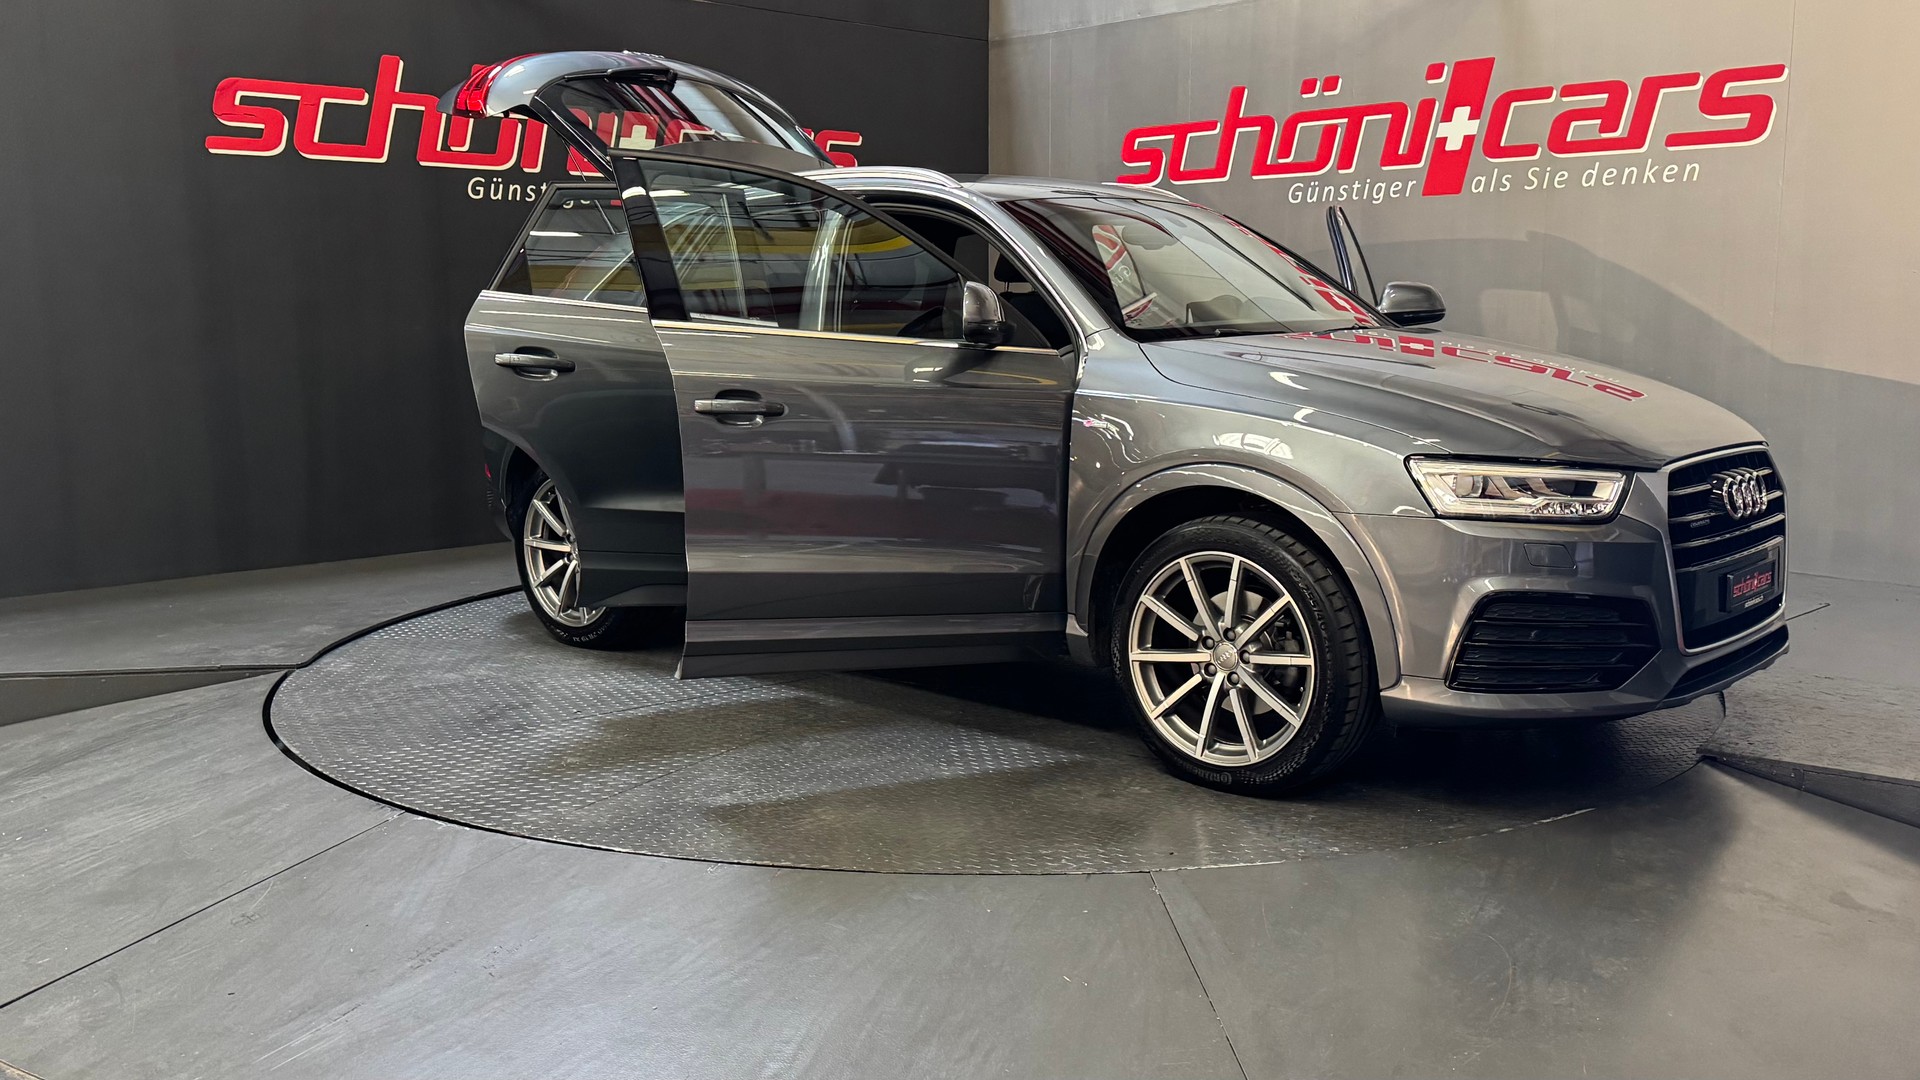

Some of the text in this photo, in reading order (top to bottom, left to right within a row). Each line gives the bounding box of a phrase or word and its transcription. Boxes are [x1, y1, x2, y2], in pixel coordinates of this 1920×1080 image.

[1288, 158, 1701, 204] Günstiger als Sie denken
